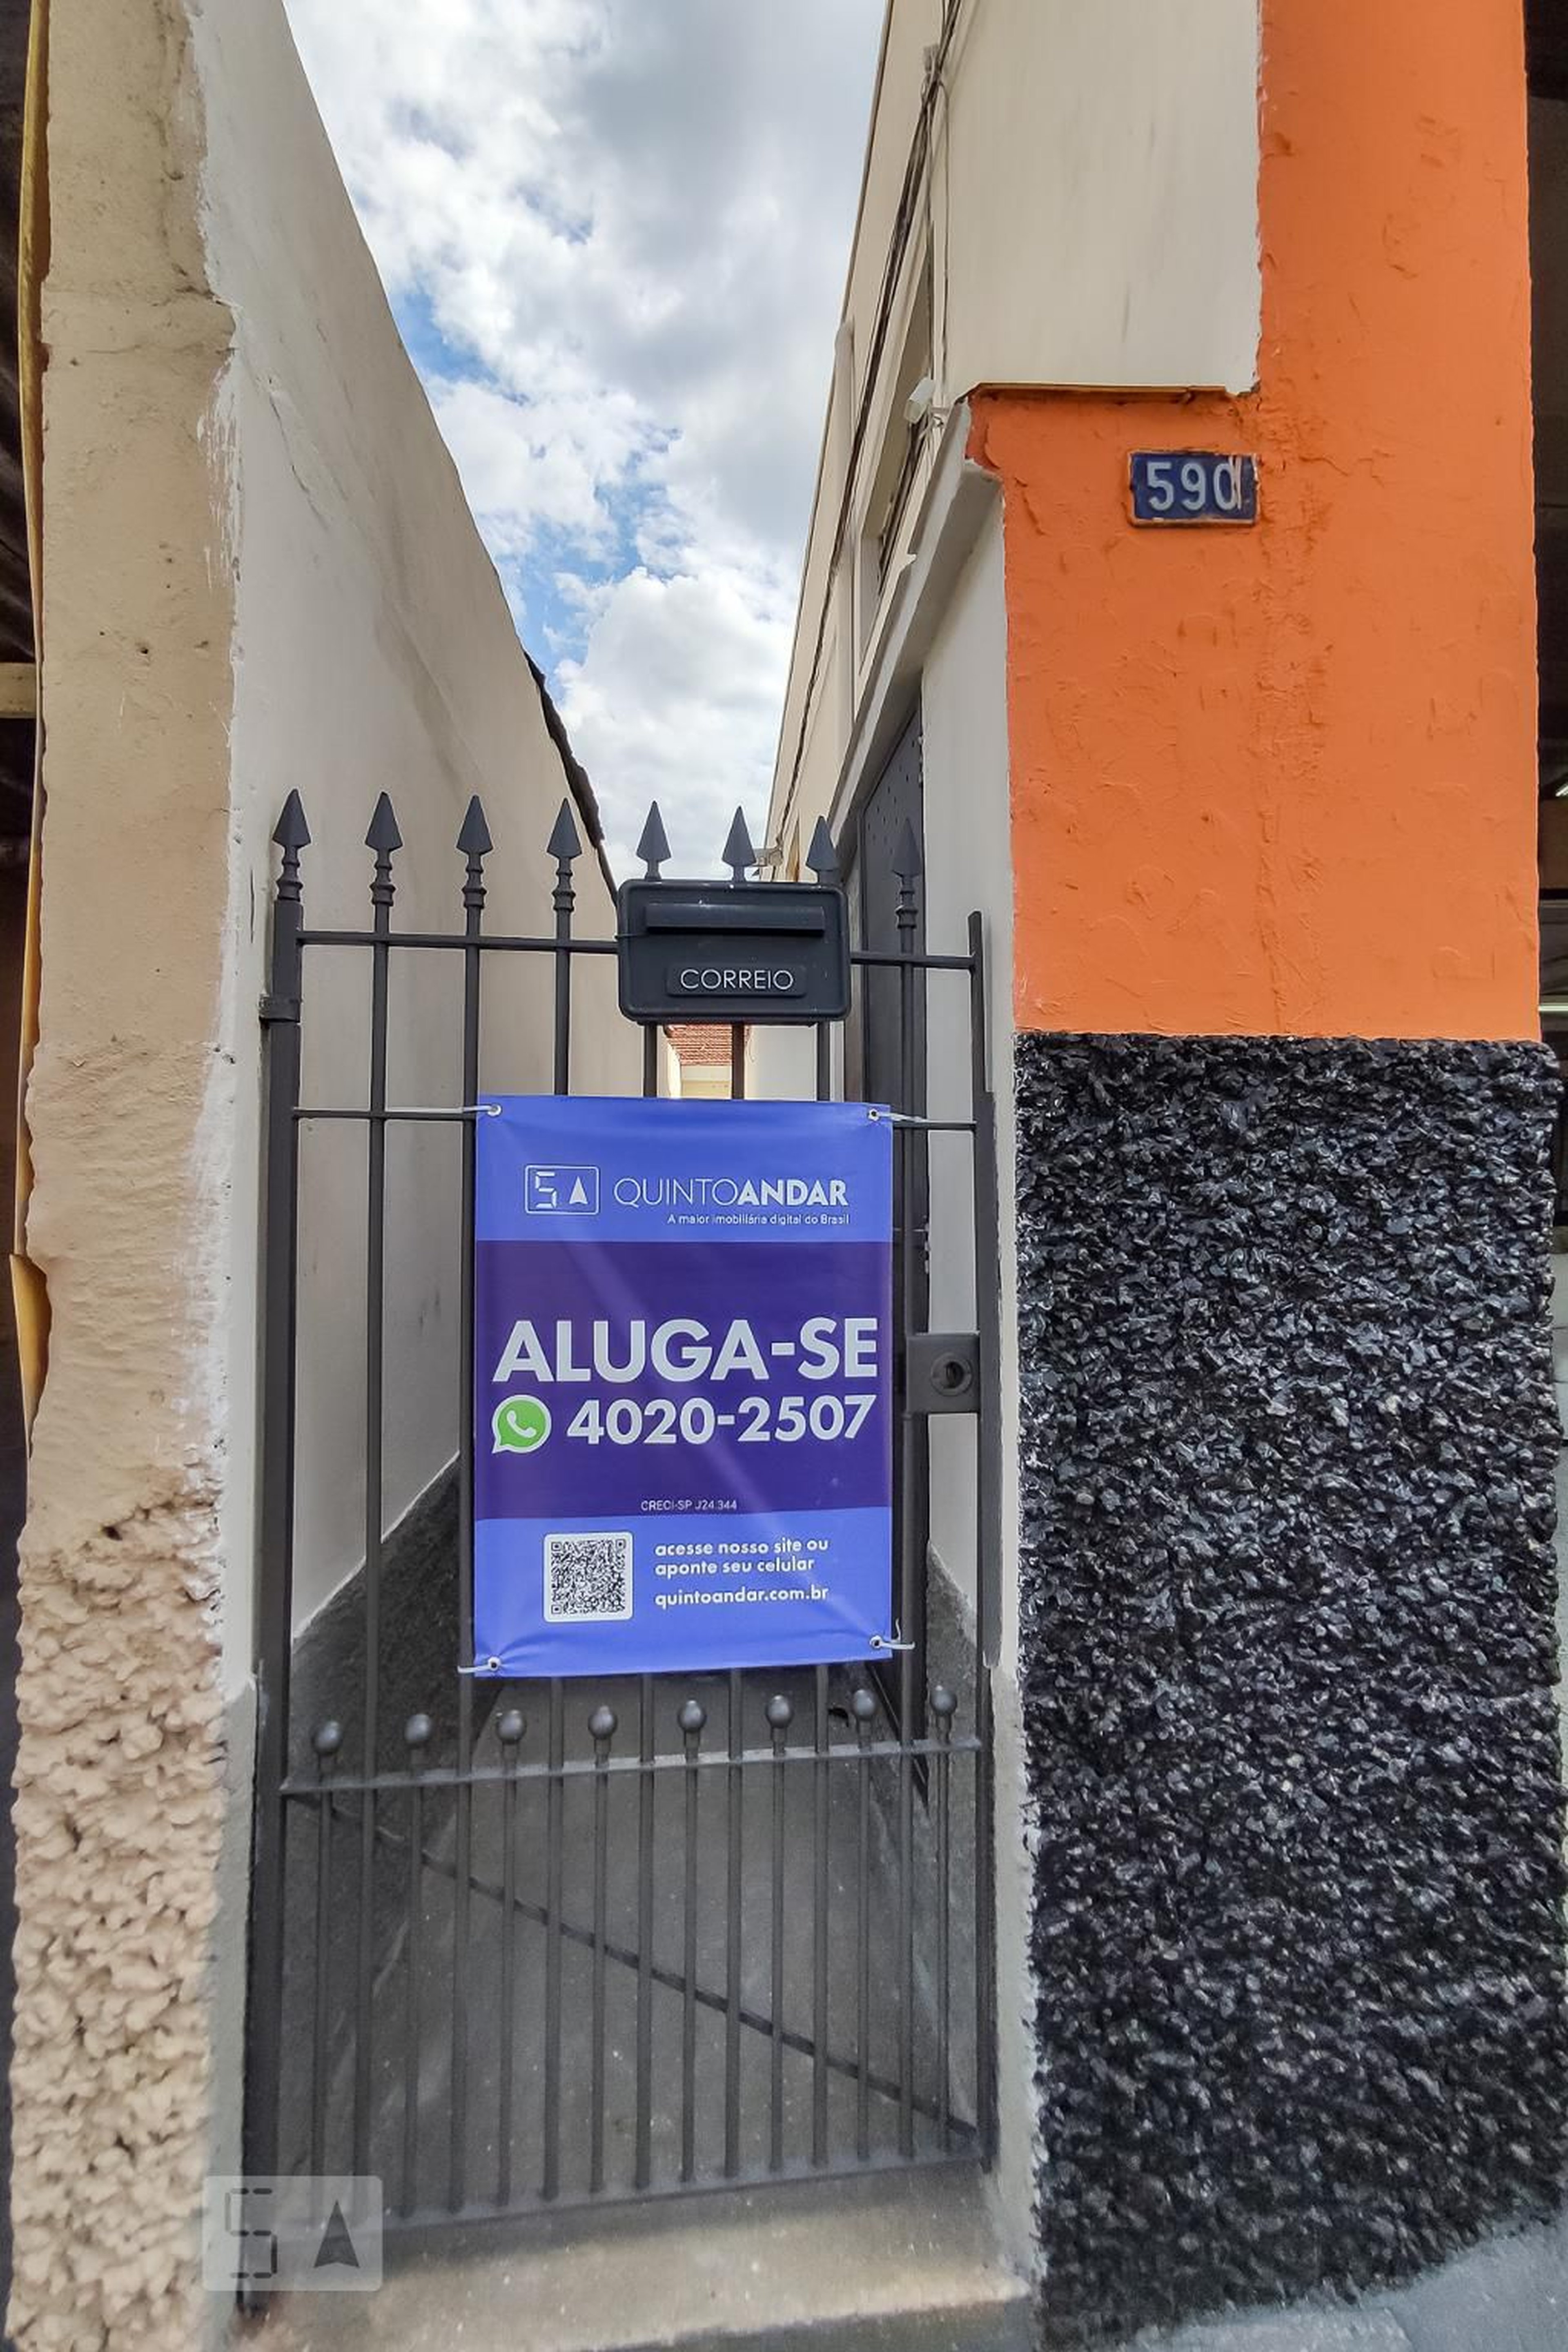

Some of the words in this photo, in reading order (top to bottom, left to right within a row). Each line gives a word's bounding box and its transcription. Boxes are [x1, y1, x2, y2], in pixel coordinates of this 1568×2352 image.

[1147, 461, 1236, 510] 590
[680, 969, 793, 990] CORREIO
[667, 1214, 676, 1224] A
[679, 1214, 709, 1224] maior
[770, 1214, 801, 1225] digital
[805, 1214, 818, 1224] do
[820, 1214, 849, 1224] Brasil
[492, 1317, 878, 1382] ALUGA-SE
[567, 1394, 877, 1445] 4020-2507
[655, 1543, 713, 1556] acesse
[719, 1543, 768, 1554] nosso
[774, 1537, 801, 1553] site
[807, 1539, 828, 1551] ou
[655, 1561, 717, 1579] aponte
[723, 1562, 752, 1573] seu
[757, 1556, 815, 1572] celular
[655, 1585, 829, 1610] quintoandar.com.br
